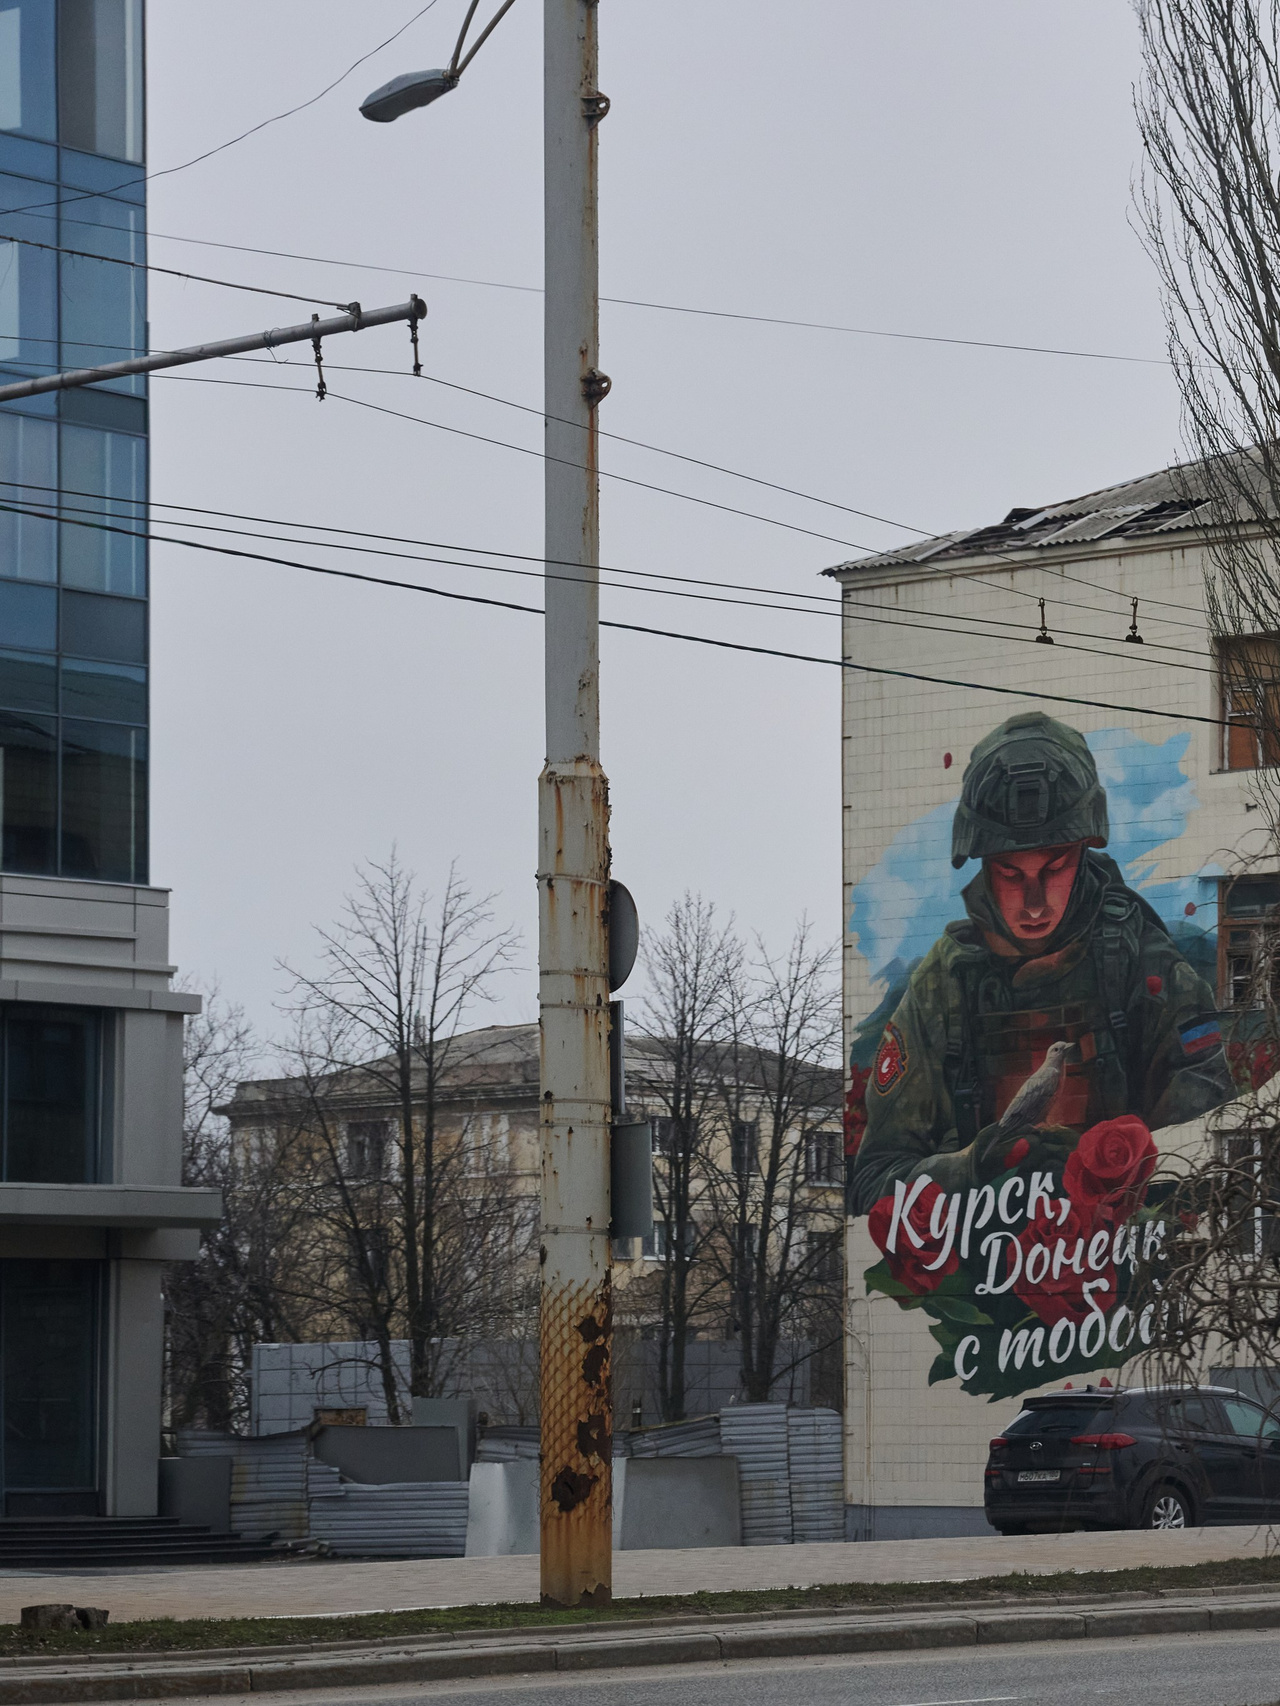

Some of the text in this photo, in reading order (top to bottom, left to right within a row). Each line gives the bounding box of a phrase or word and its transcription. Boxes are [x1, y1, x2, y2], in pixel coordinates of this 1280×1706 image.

[886, 1171, 1071, 1271] Курск,
[975, 1219, 1168, 1295] Донецк
[954, 1335, 980, 1381] с
